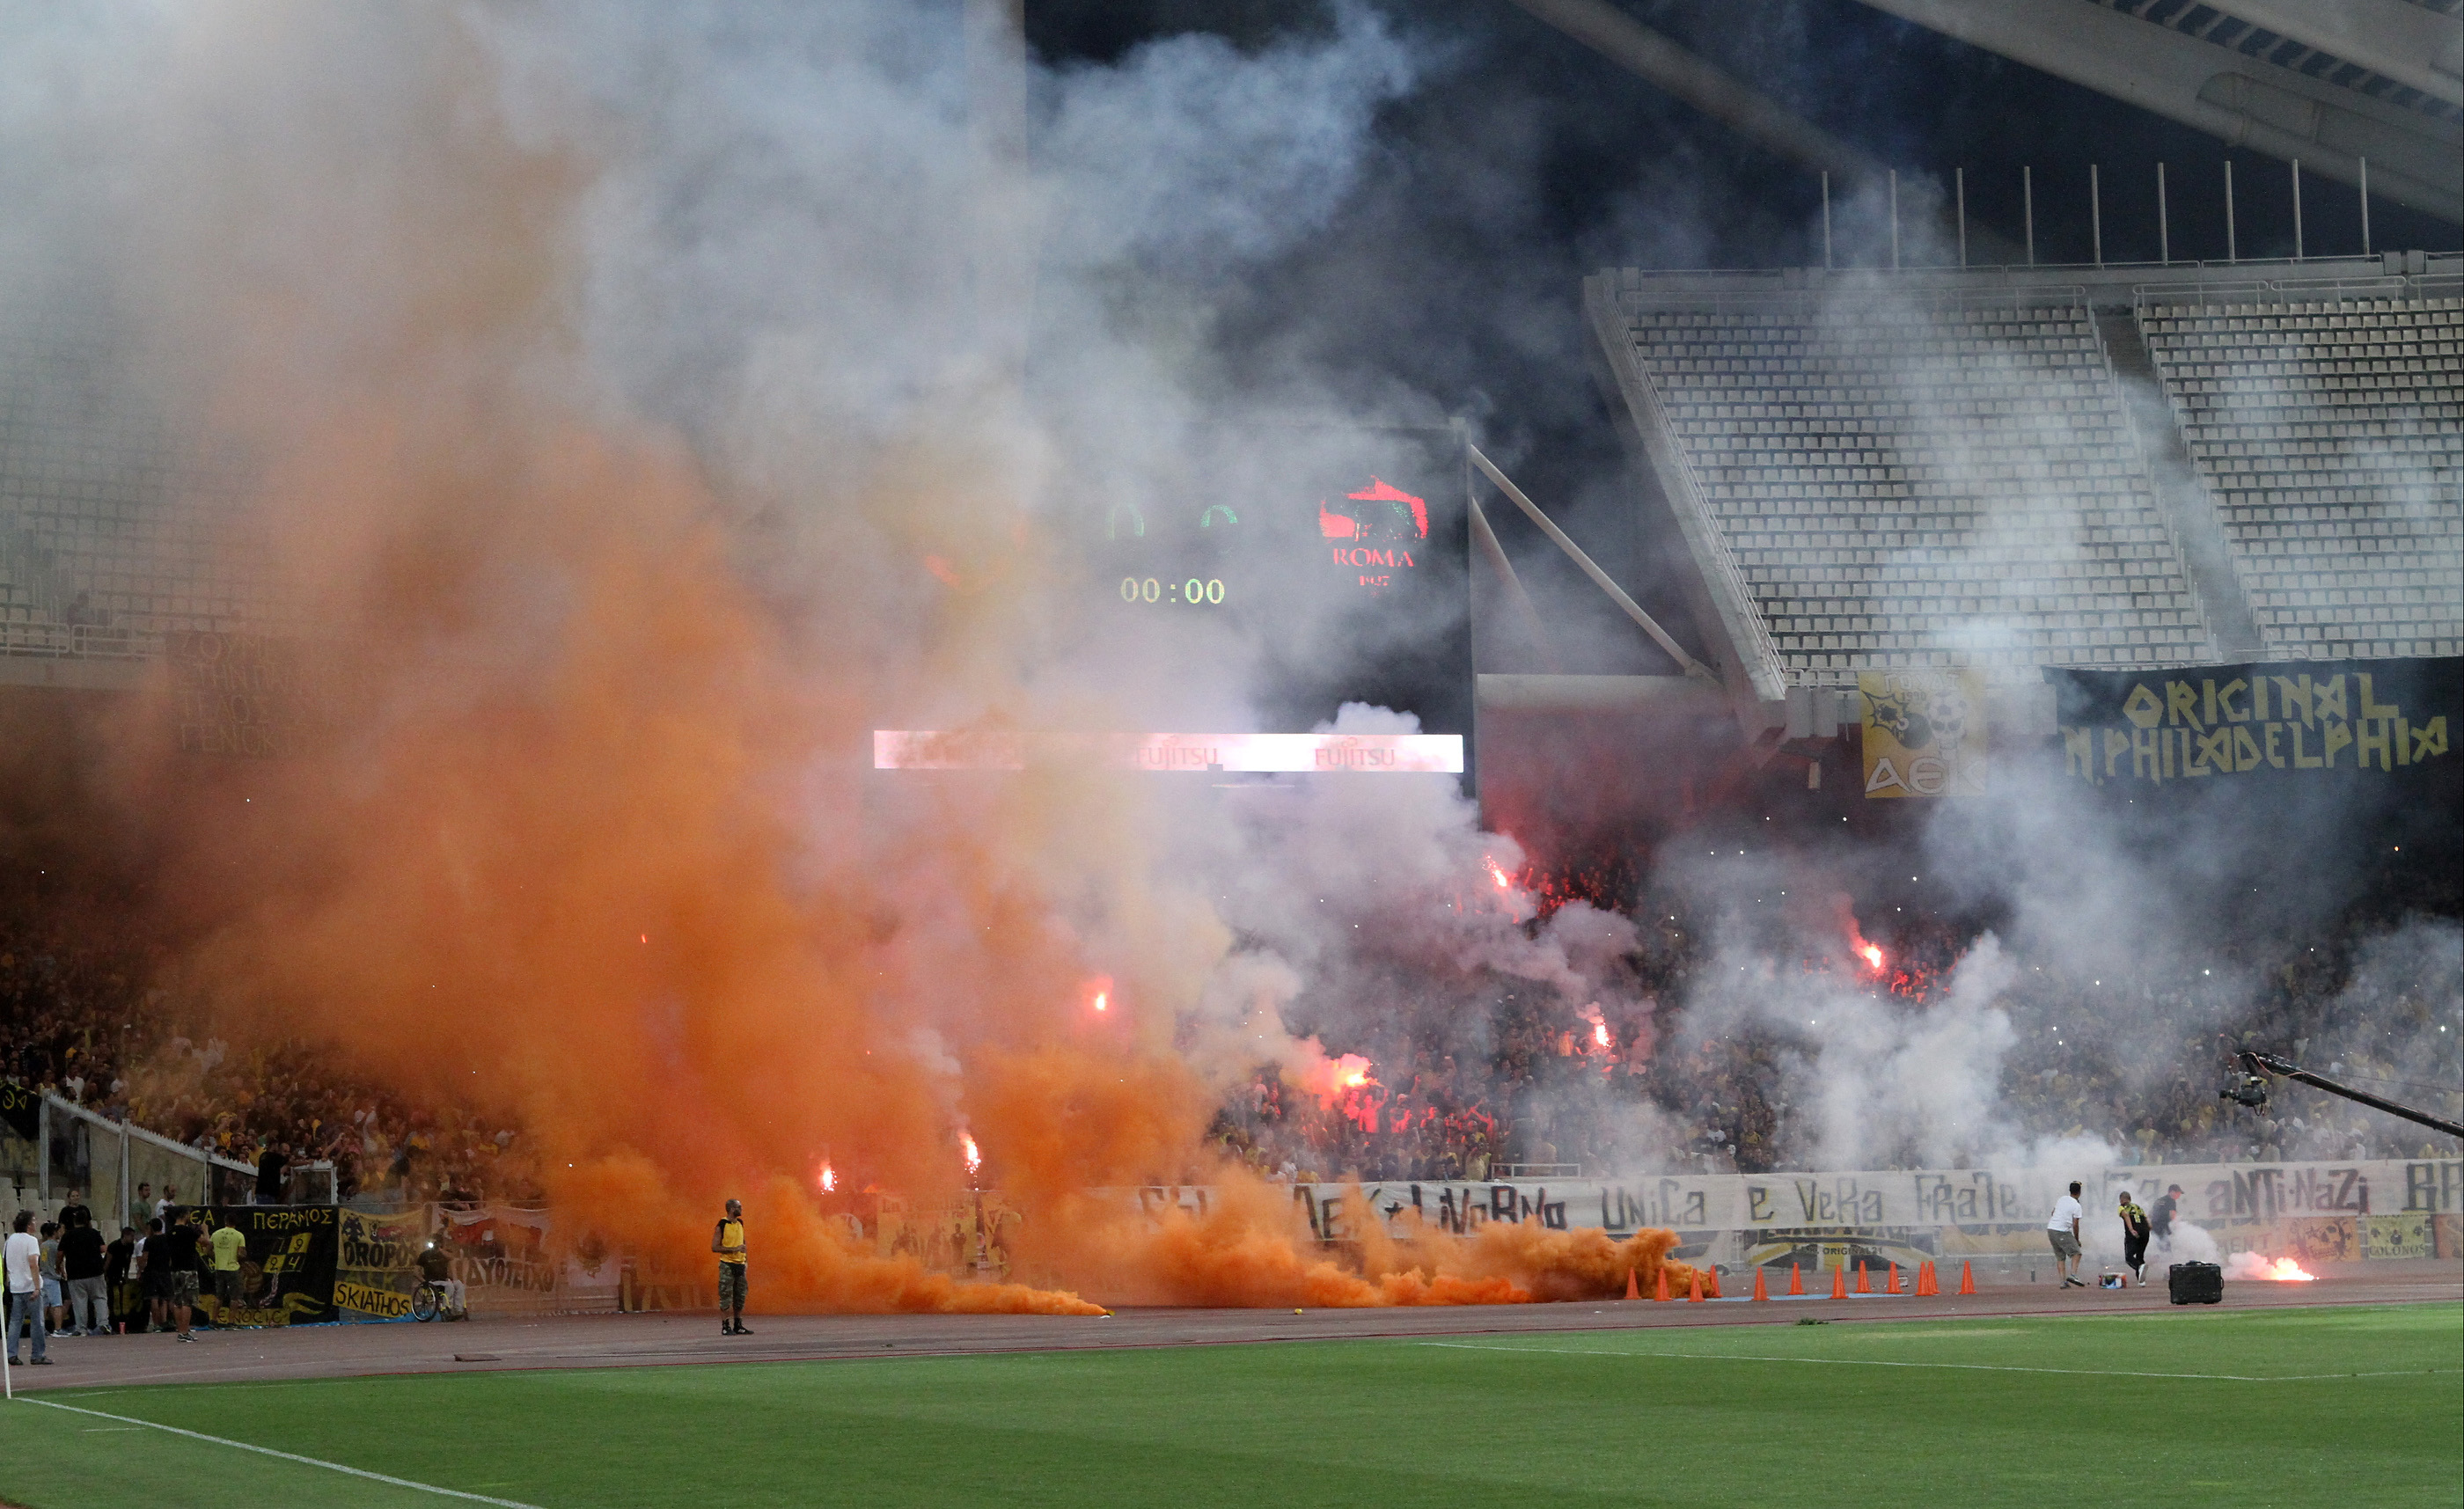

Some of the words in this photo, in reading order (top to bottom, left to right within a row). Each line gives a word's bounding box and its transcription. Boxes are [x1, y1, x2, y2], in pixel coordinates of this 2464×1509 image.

[1332, 547, 1414, 568] ROMA
[1120, 576, 1225, 604] 00:00
[1137, 744, 1218, 768] FUJITSU
[1315, 744, 1395, 768] FUJITSU
[253, 1208, 334, 1230] ΠΕΡΑΜΟΣ
[2368, 1243, 2425, 1256] COLONOS
[336, 1284, 411, 1316] SKIATHOS
